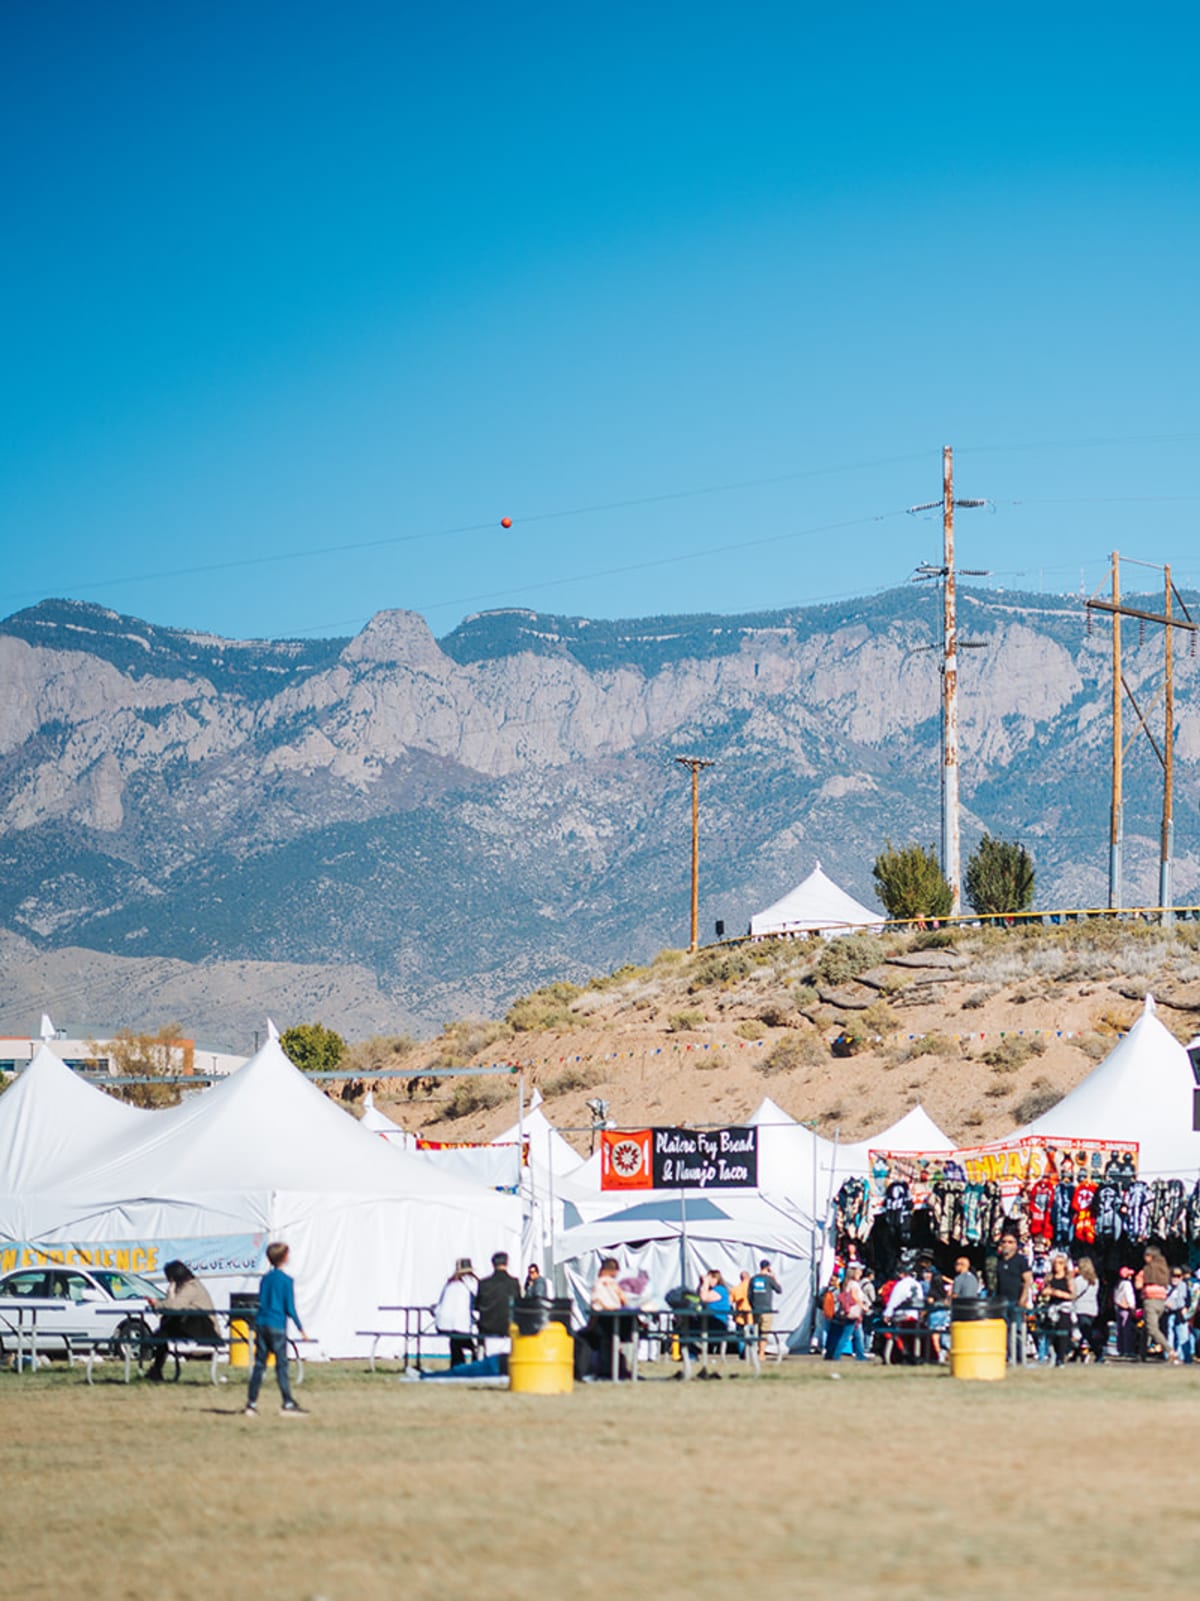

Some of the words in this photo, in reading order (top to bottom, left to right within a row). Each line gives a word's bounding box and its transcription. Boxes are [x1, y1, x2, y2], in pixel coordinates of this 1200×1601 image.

[697, 1133, 718, 1160] Fry
[720, 1131, 755, 1153] Bread
[662, 1159, 673, 1181] &
[676, 1160, 716, 1187] Navajo
[718, 1159, 747, 1181] Tacos
